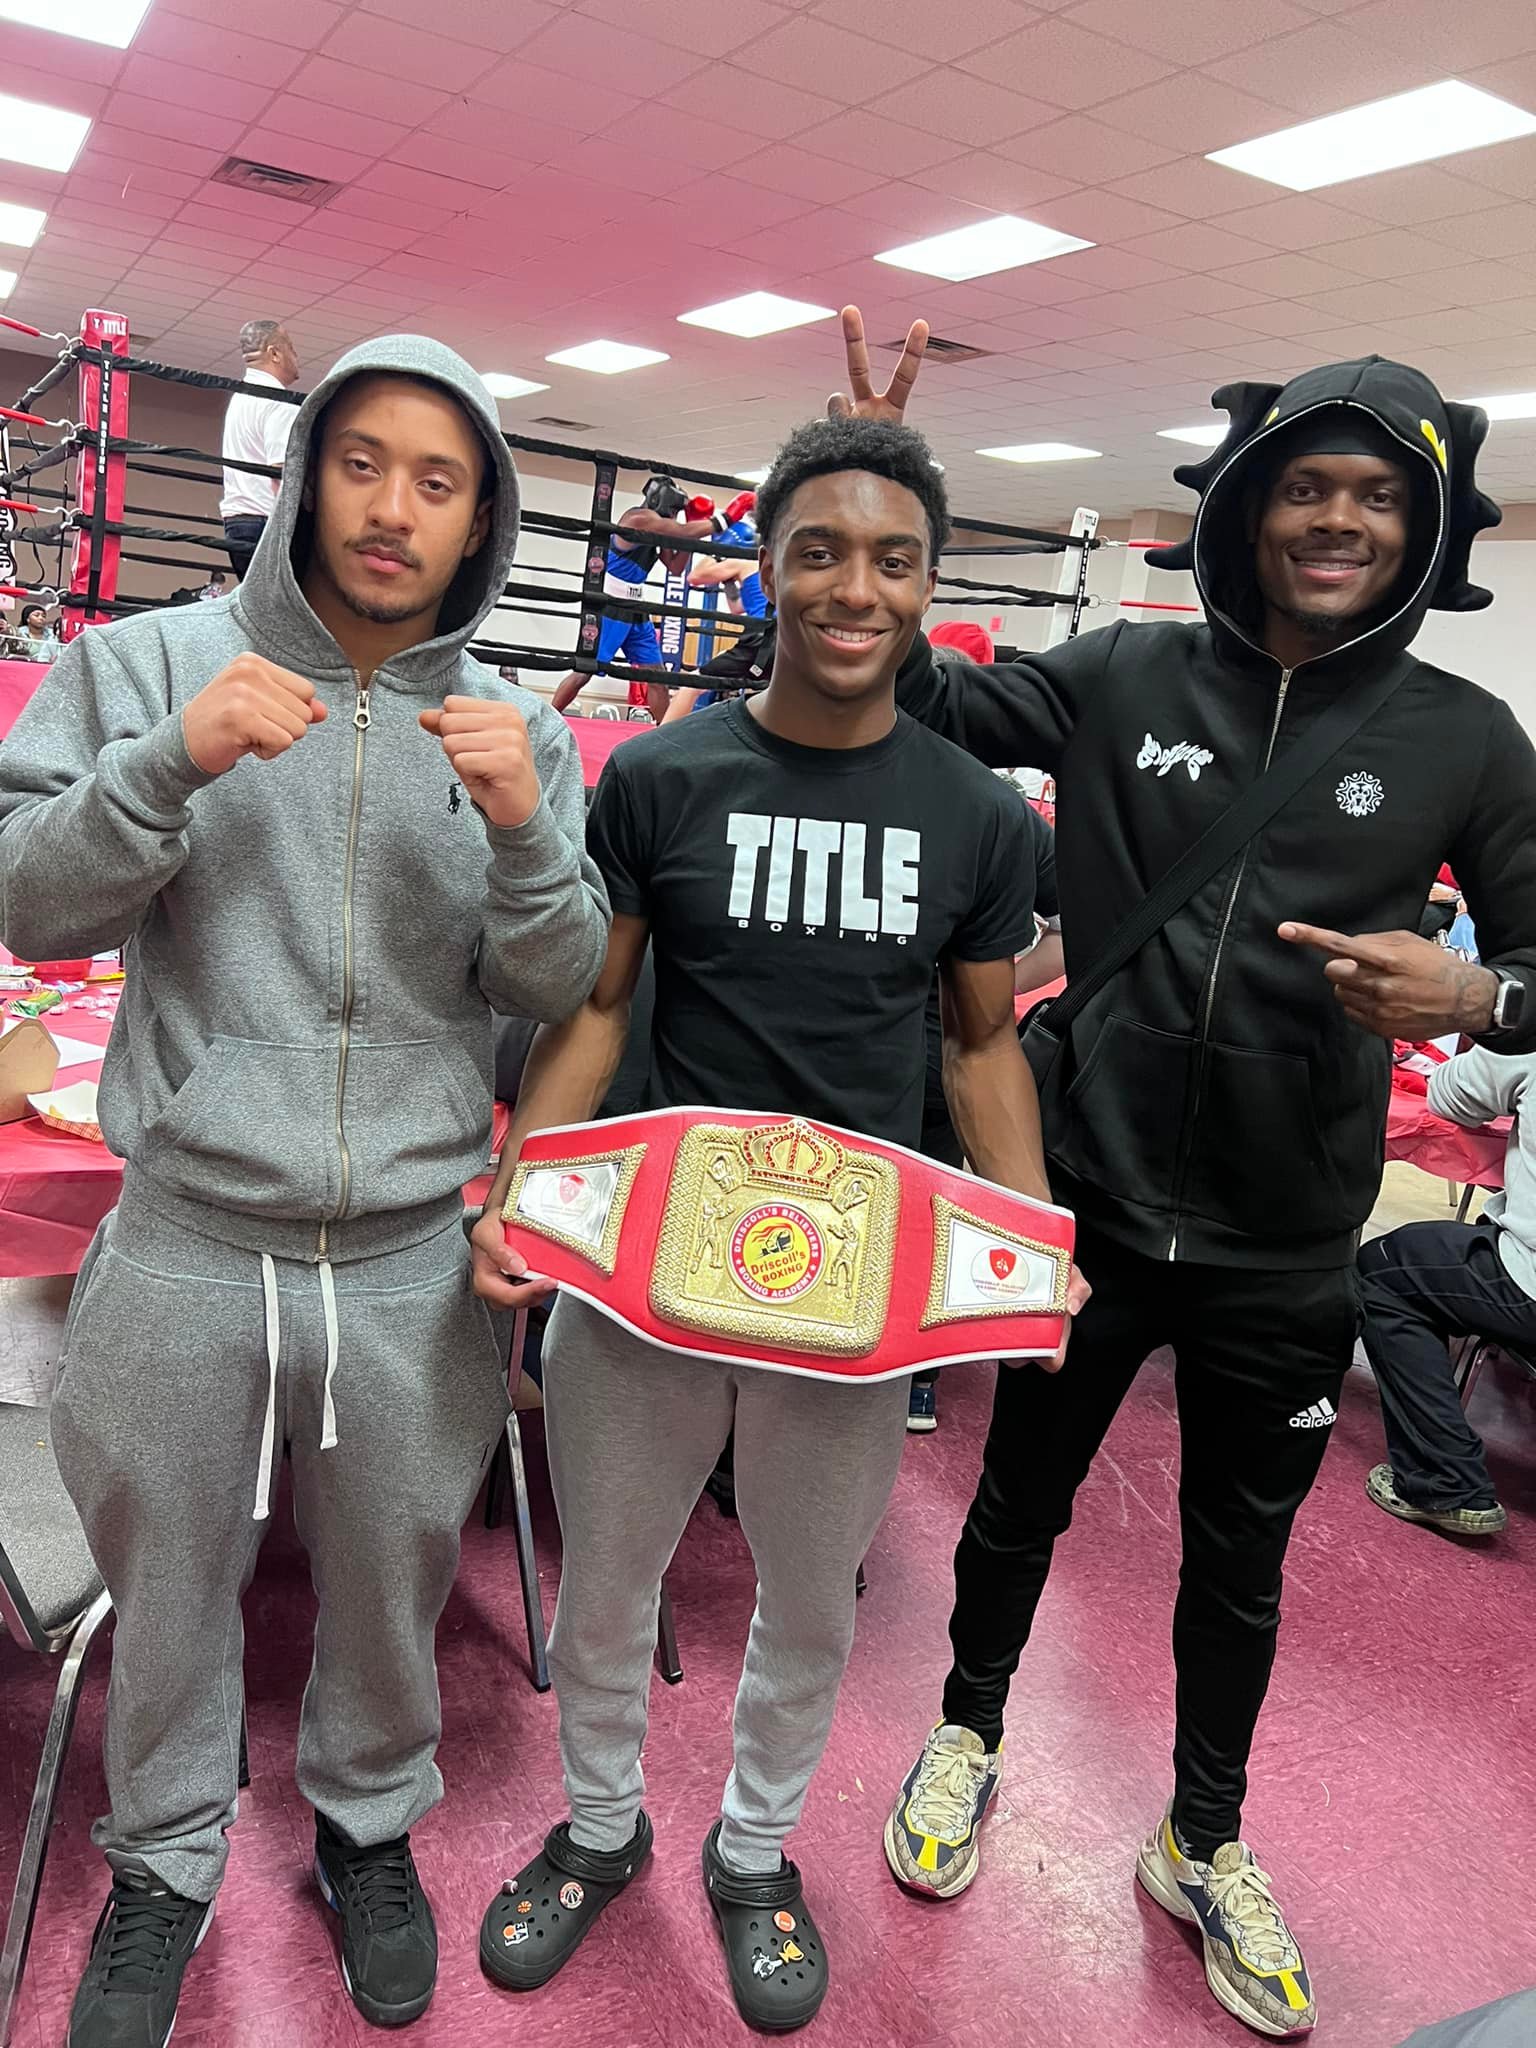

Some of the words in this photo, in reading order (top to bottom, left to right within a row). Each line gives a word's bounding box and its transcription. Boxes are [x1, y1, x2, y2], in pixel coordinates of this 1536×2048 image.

[102, 359, 111, 413] TITLE
[726, 812, 921, 936] TITLE
[737, 919, 908, 946] BOXING
[733, 1207, 778, 1253] DRISCOLL'S
[781, 1207, 820, 1259] BELIEVERS
[750, 1250, 807, 1276] Driscoll's
[762, 1263, 804, 1284] BOXING
[738, 1266, 770, 1297] BOXING
[770, 1273, 813, 1299] ACADEMY
[1288, 1412, 1338, 1429] adidas
